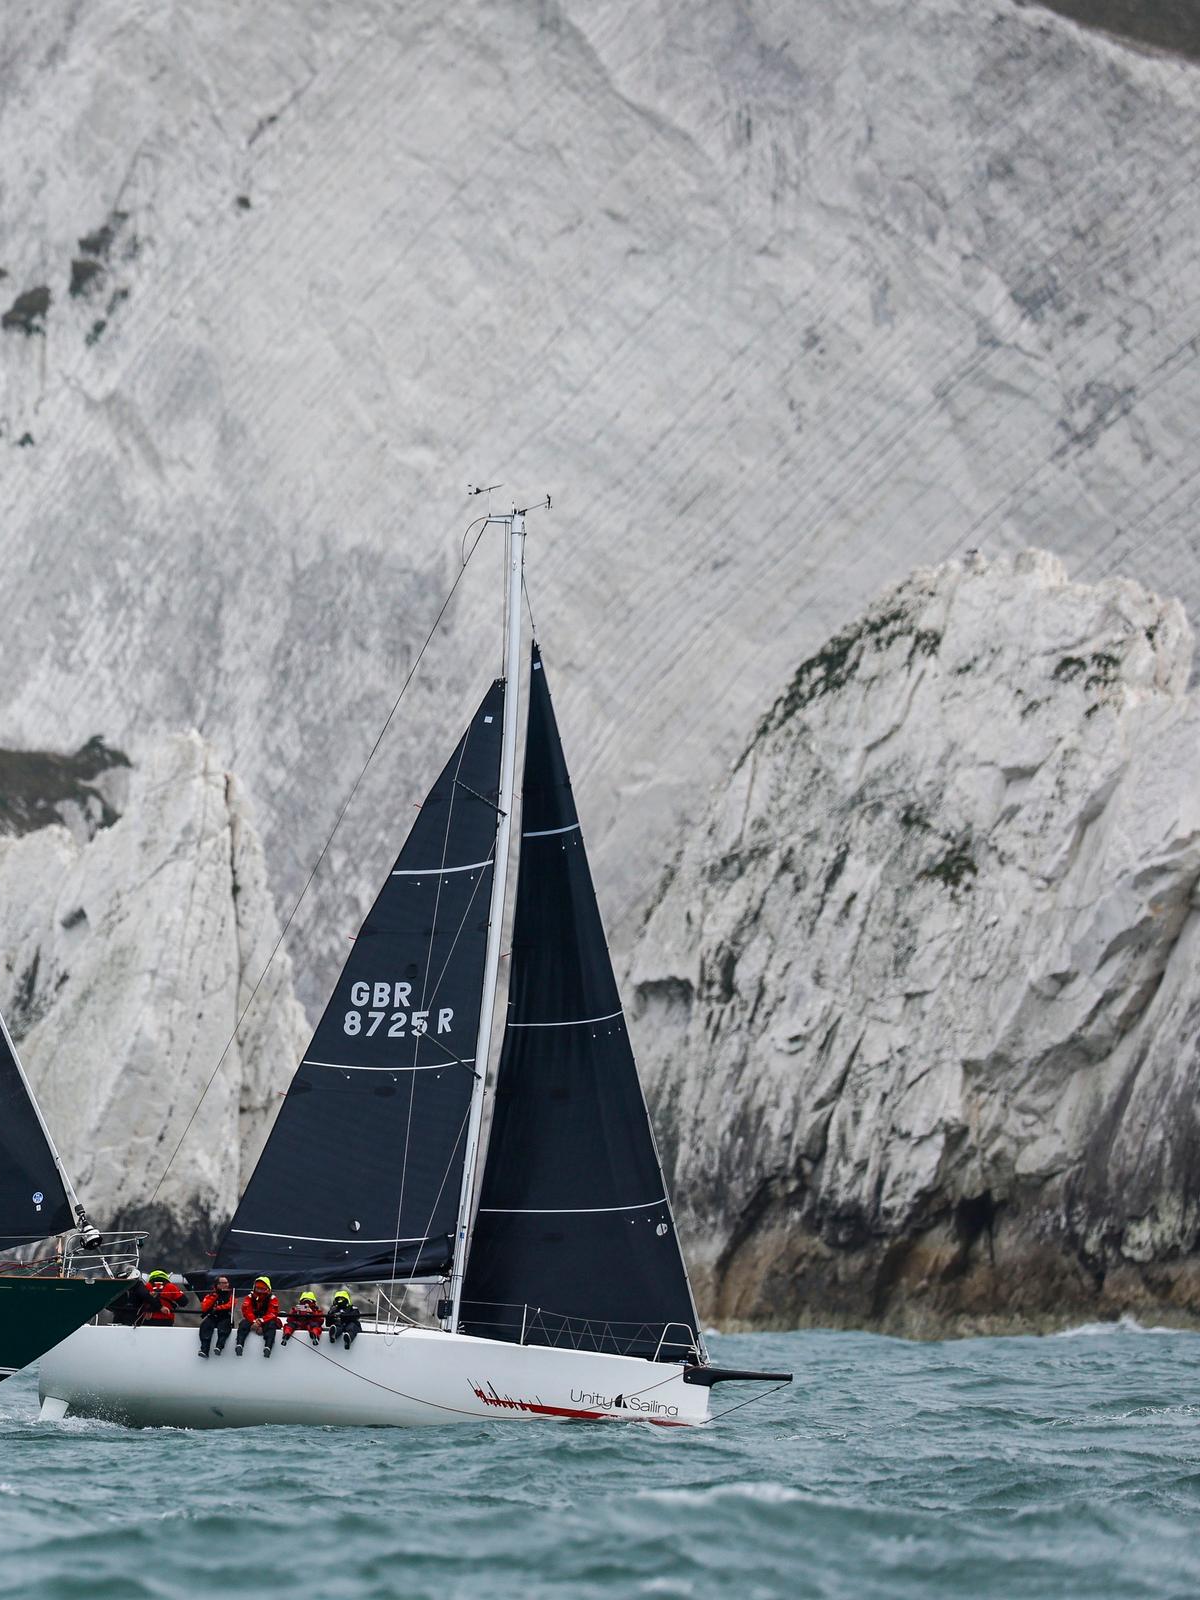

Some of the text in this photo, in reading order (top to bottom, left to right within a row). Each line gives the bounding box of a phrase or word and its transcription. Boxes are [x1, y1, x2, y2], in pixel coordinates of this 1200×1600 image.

[351, 981, 412, 1008] GBR
[343, 1007, 454, 1038] 8725 R
[570, 1389, 679, 1418] Unity Sailing
